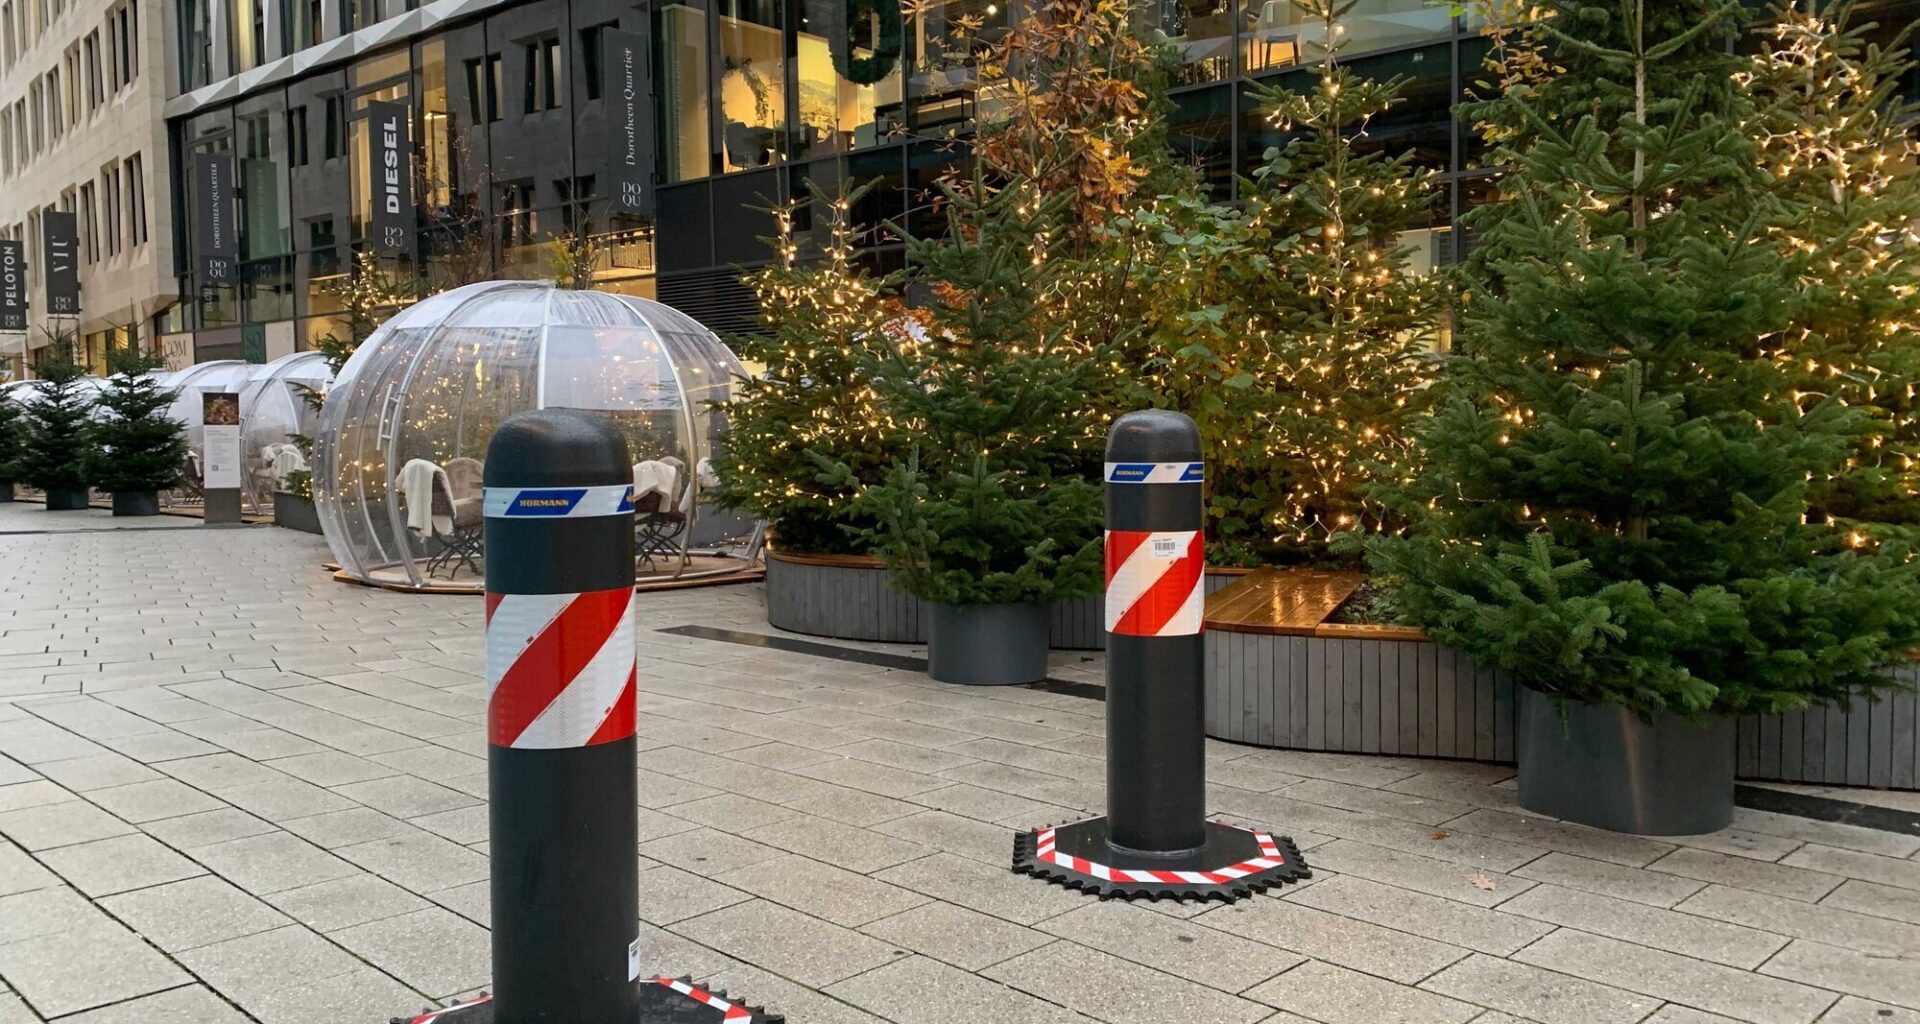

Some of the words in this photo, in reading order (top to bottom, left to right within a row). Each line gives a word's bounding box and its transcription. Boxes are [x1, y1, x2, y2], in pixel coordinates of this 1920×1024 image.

[623, 47, 636, 100] Quartier
[623, 102, 636, 166] Dorotheen
[211, 163, 220, 201] QUARTIER
[383, 116, 400, 214] DIESEL
[213, 202, 221, 249] DOROTHEEN
[3, 246, 17, 307] PELOTON
